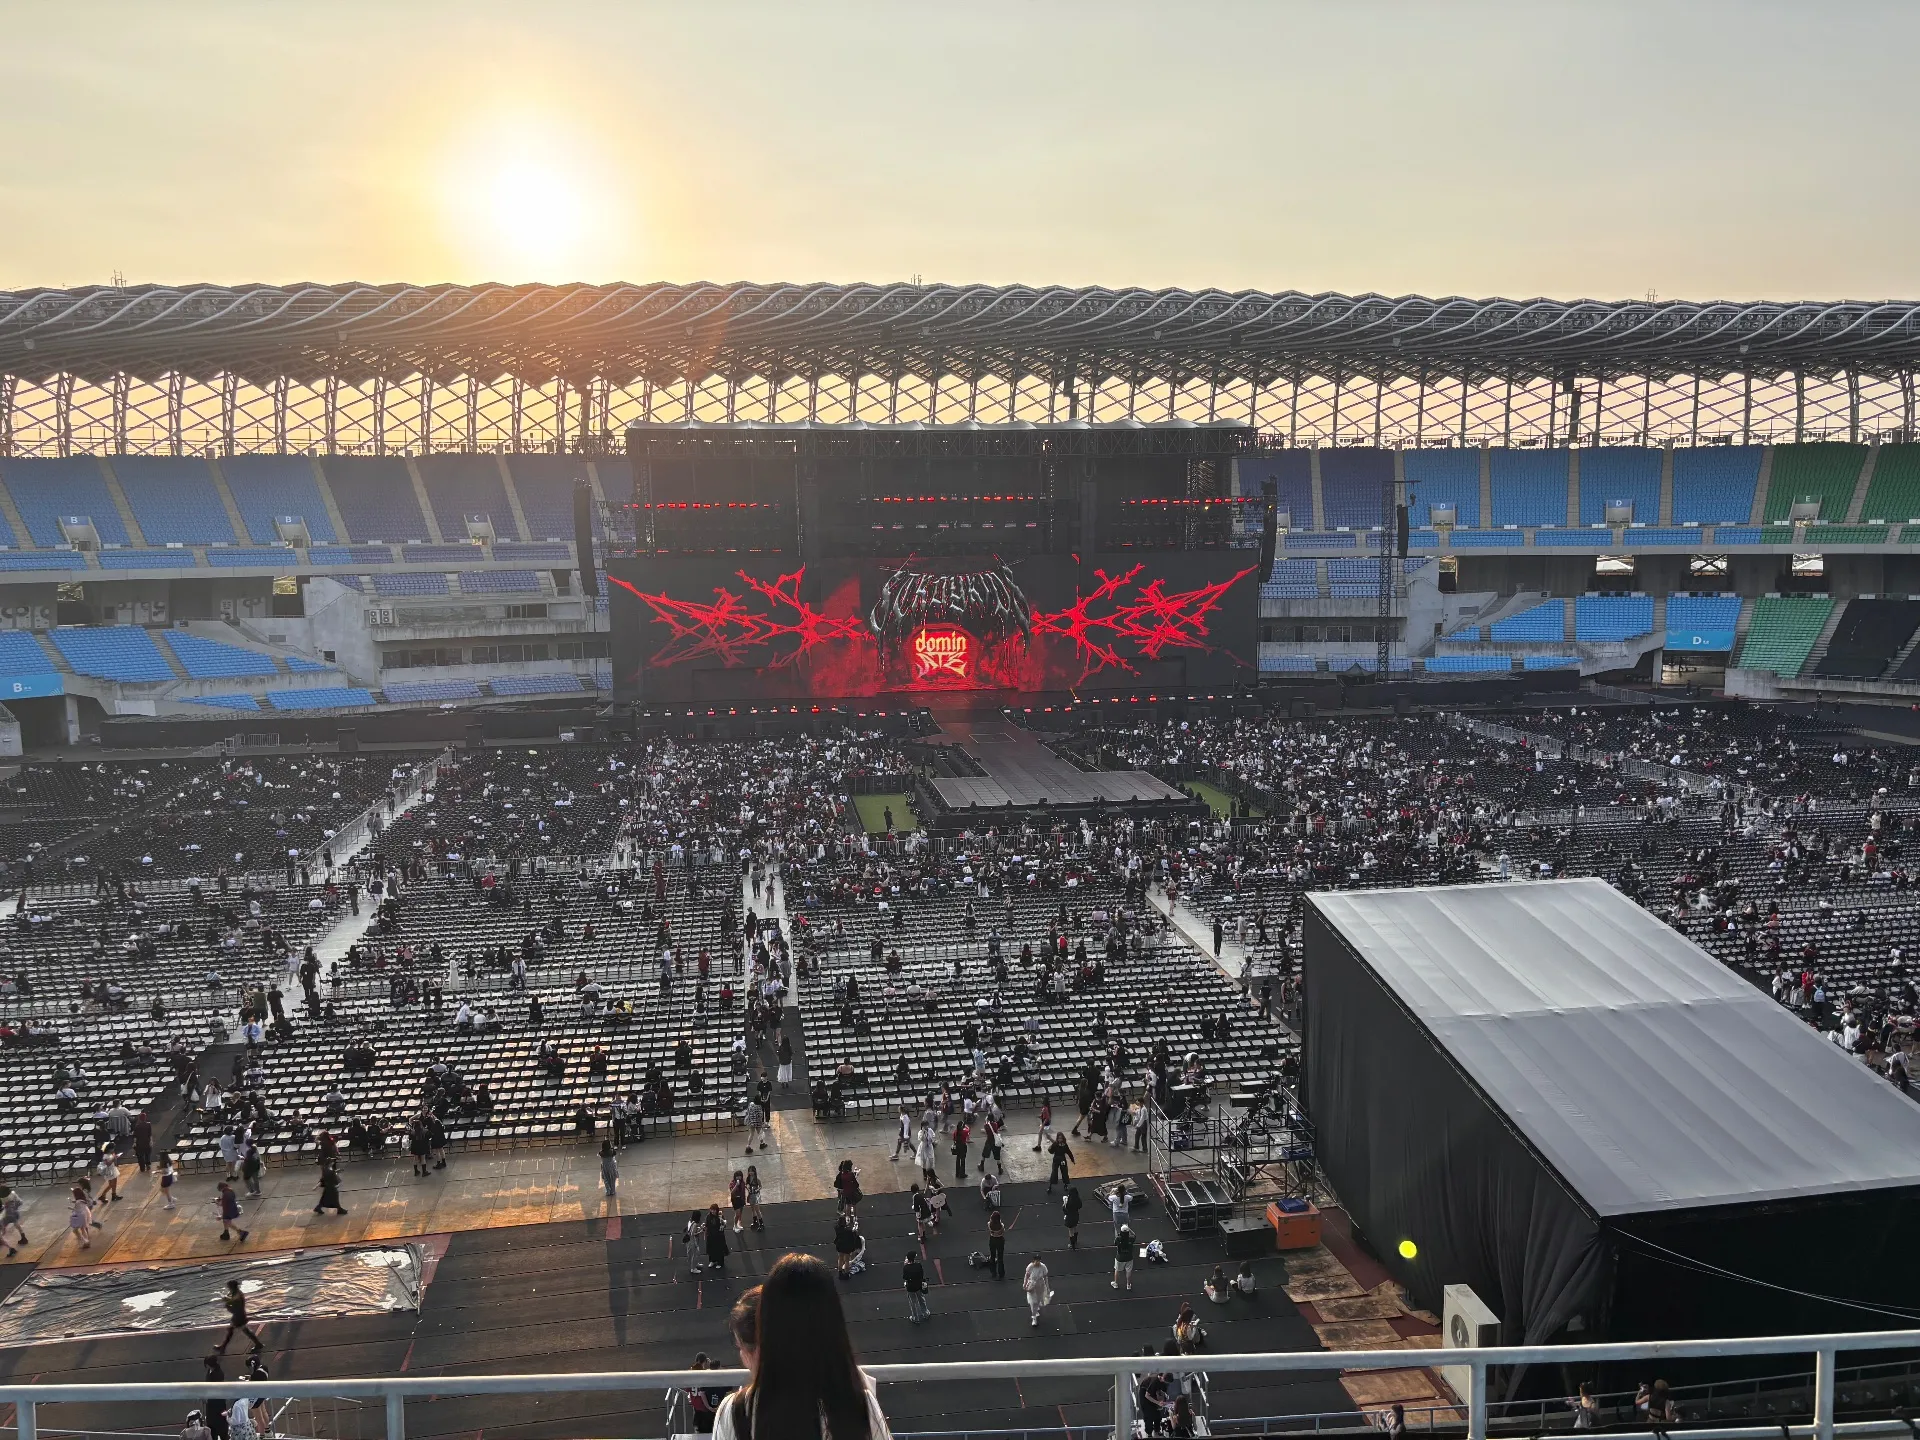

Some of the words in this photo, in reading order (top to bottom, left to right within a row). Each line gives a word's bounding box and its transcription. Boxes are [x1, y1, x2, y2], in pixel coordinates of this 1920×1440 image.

[70, 516, 78, 524] B
[285, 515, 292, 523] B
[915, 628, 967, 651] domin
[1692, 636, 1702, 645] D
[13, 682, 23, 693] B
